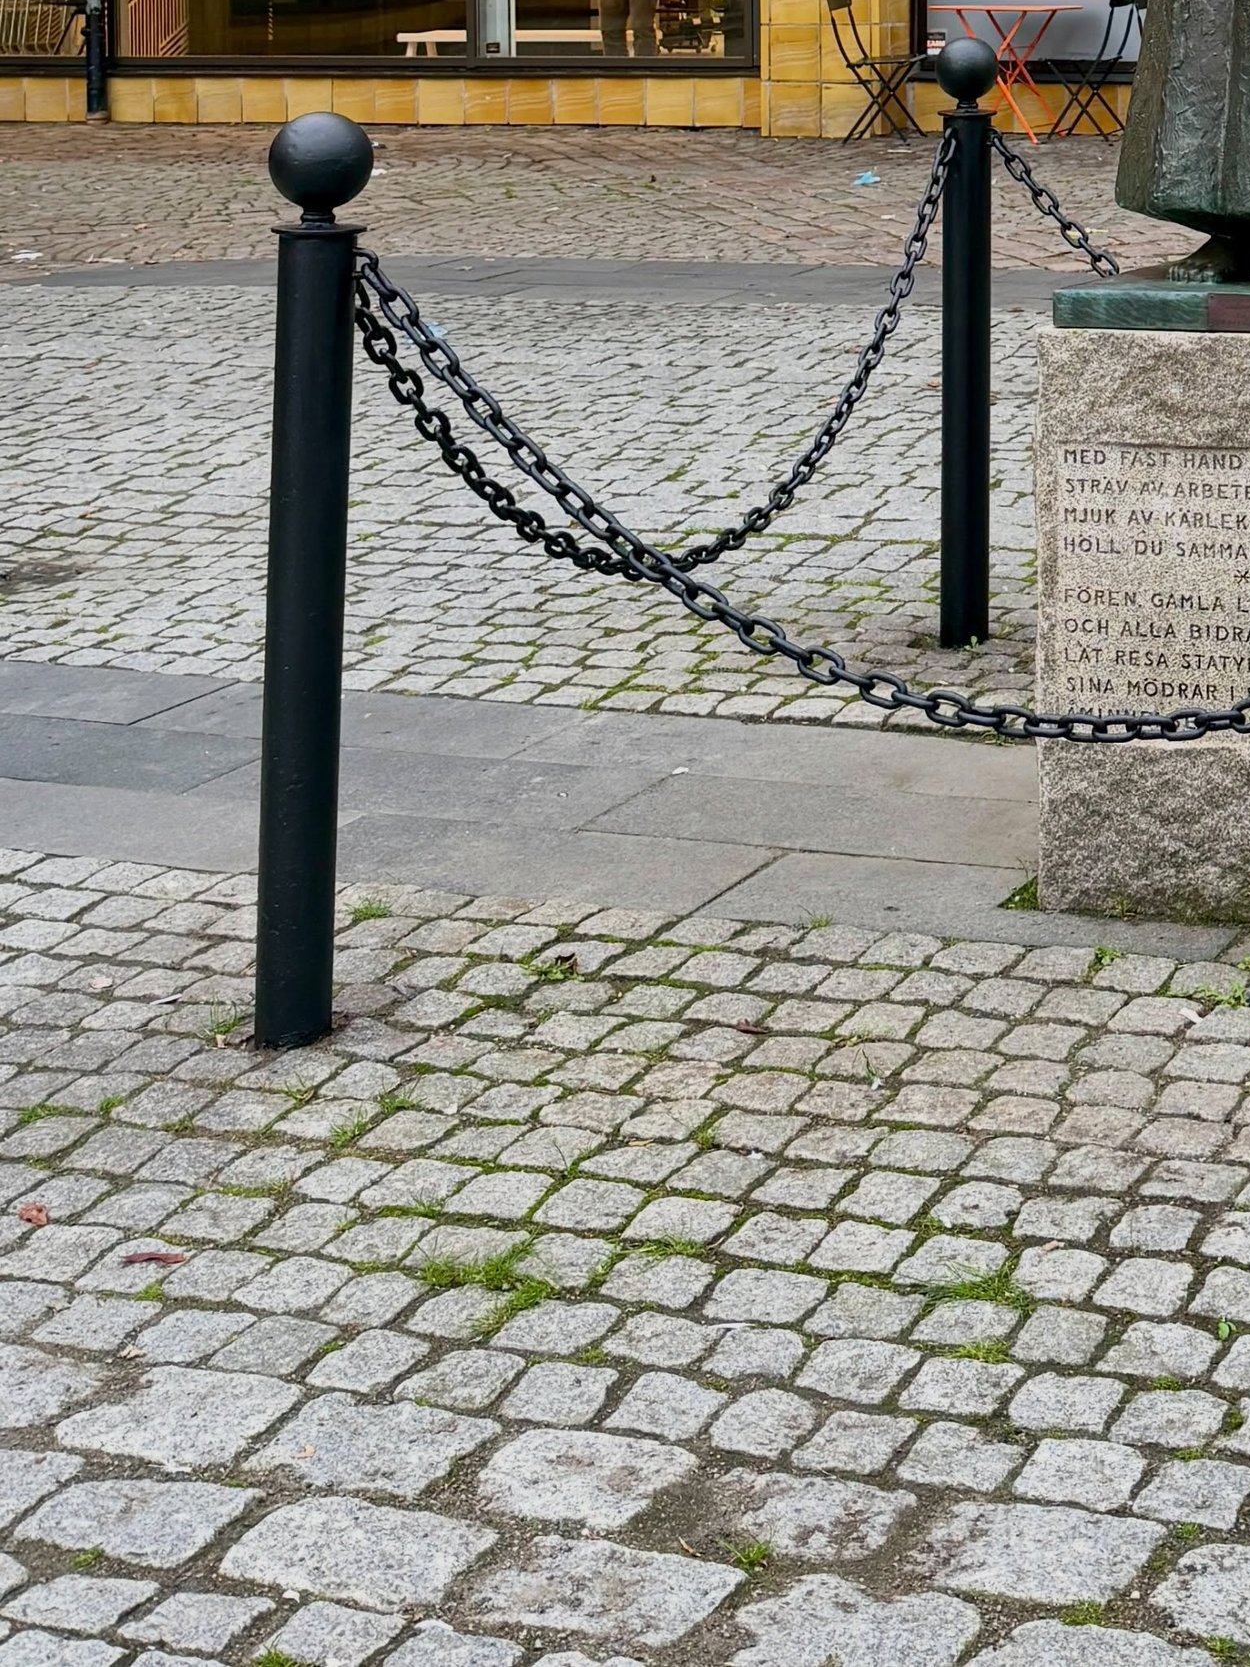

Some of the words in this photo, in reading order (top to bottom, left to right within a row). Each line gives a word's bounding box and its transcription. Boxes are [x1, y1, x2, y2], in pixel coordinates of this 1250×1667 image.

[1064, 449, 1107, 465] MED
[1120, 451, 1171, 468] FAST
[1183, 453, 1243, 470] HAND
[1065, 476, 1129, 494] STRÄV
[1139, 482, 1165, 496] AV
[1064, 507, 1116, 524] MJUK
[1128, 511, 1153, 525] AV
[1164, 507, 1249, 530] KÄRLEK
[1064, 534, 1121, 554] HÖLL
[1134, 540, 1164, 556] DU
[1064, 586, 1143, 608] FÖREN.
[1151, 593, 1225, 612] GAMLA
[1064, 618, 1109, 635] OCH
[1121, 621, 1177, 638] ALLA
[1115, 650, 1169, 668] RESA
[1066, 676, 1116, 695] SINA
[1127, 678, 1218, 700] MÖDRAR
[1230, 685, 1234, 701] I
